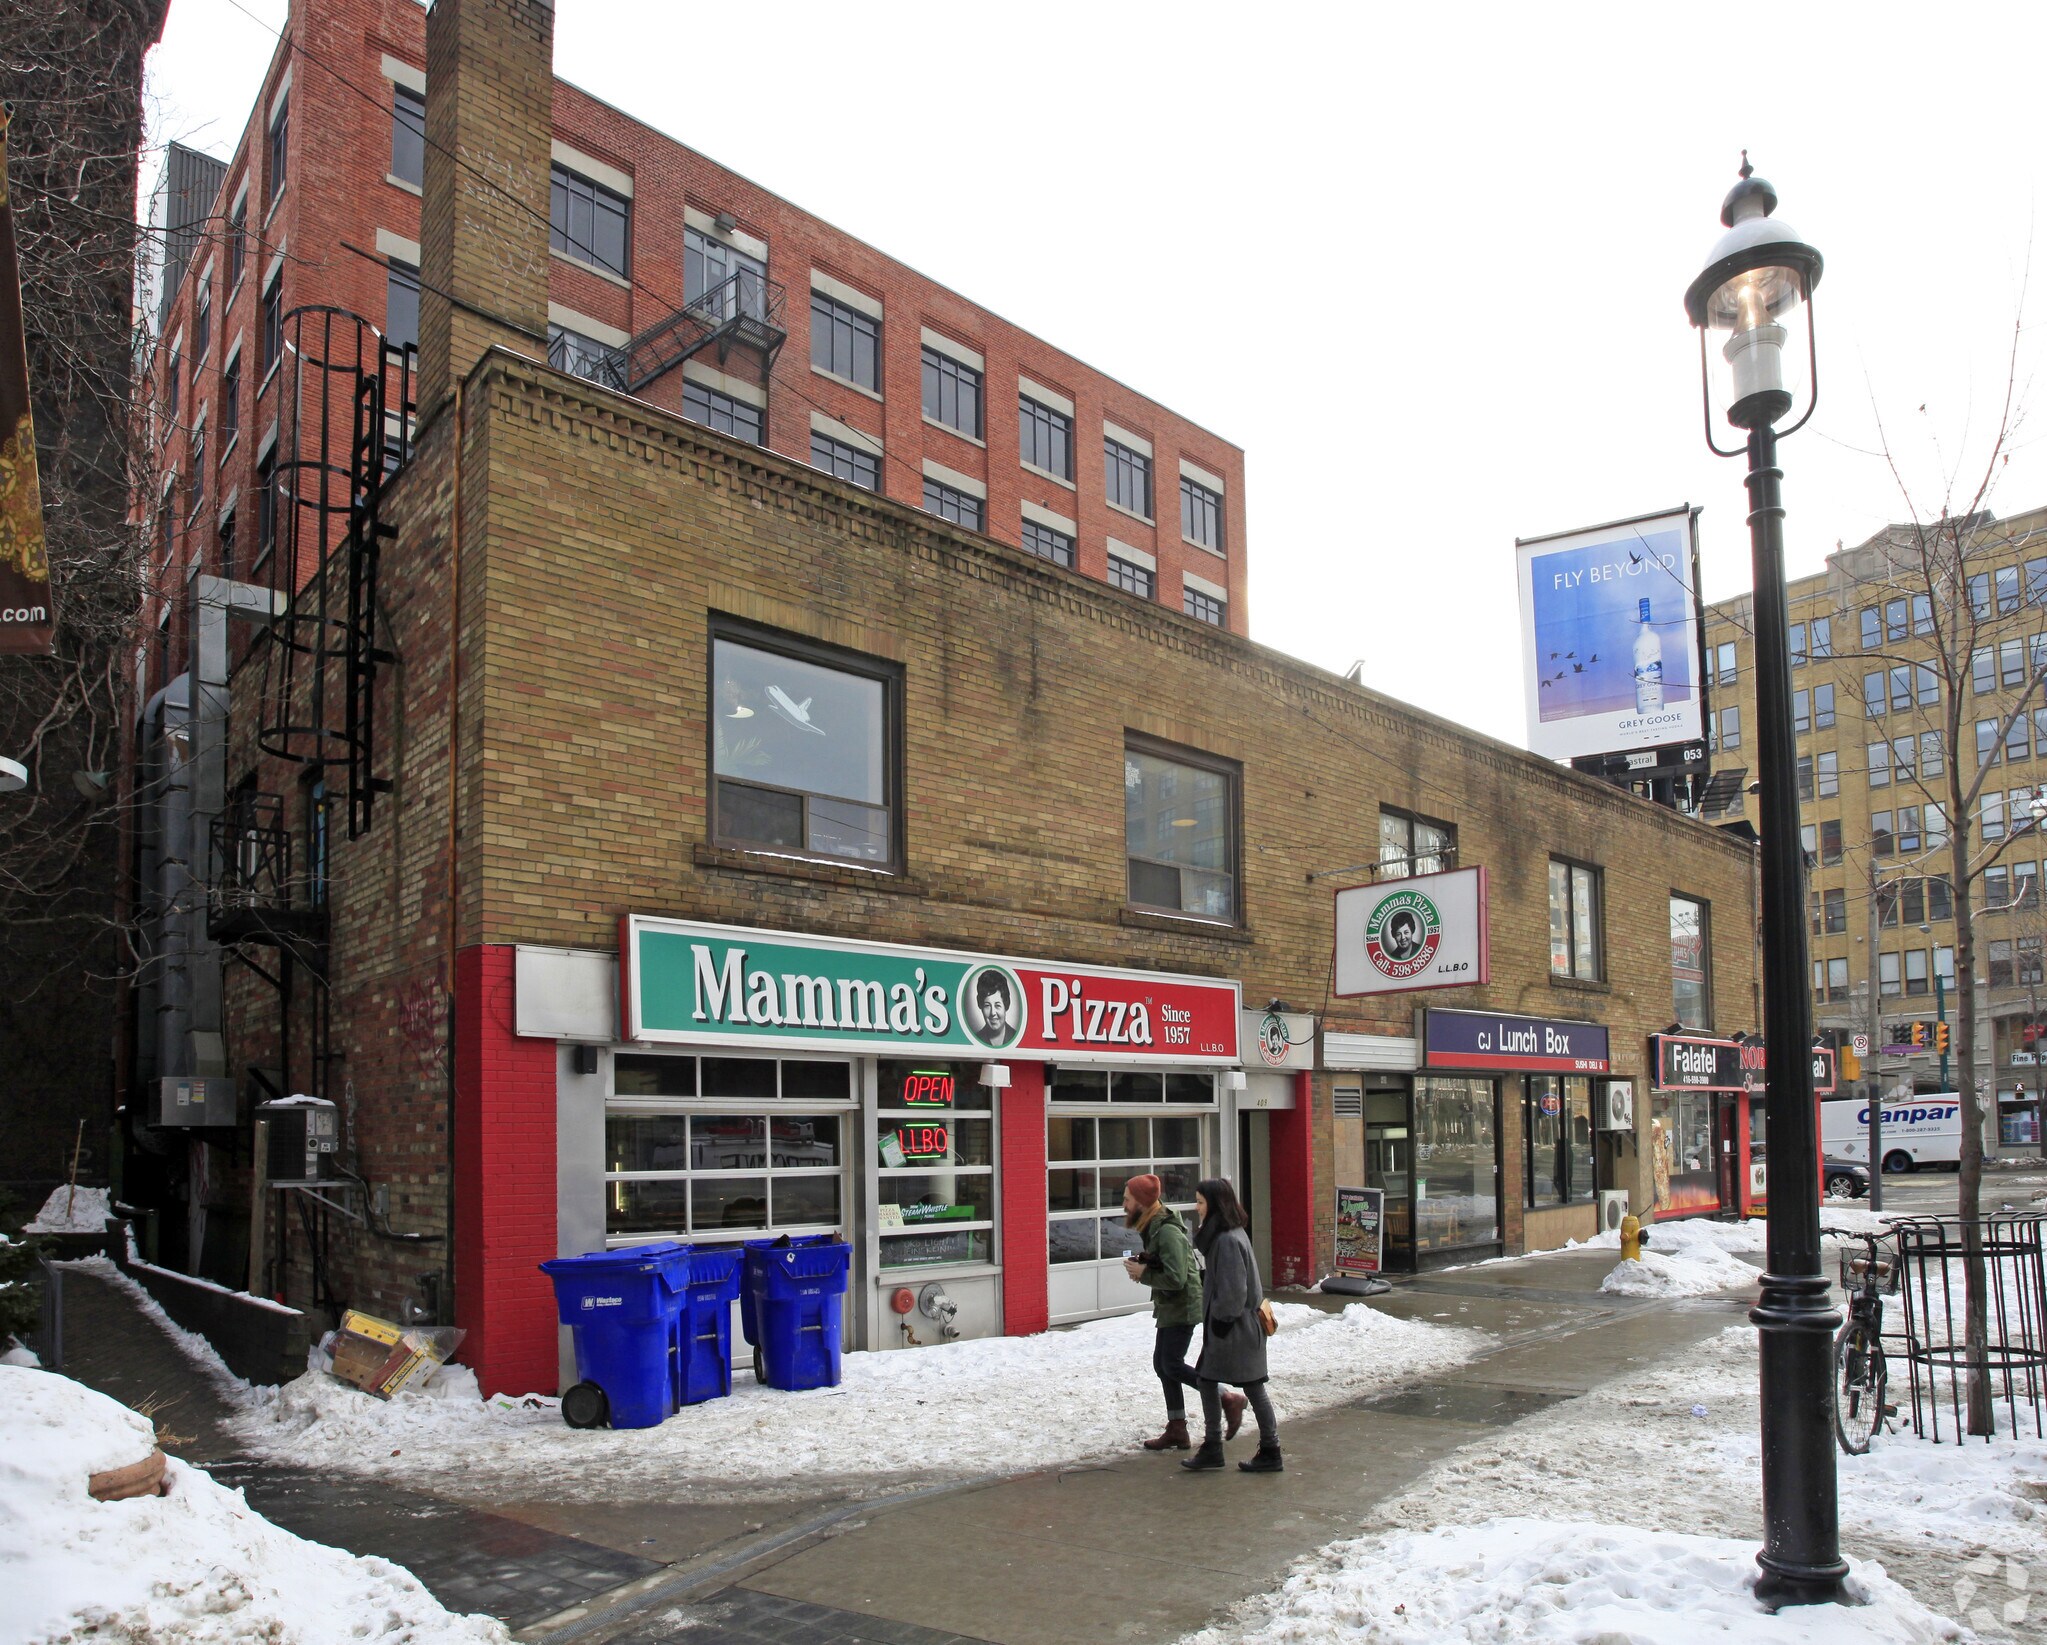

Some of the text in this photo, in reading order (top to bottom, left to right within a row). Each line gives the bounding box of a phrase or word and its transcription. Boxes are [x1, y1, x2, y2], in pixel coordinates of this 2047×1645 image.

[1554, 553, 1675, 590] FLY BEYOND
[1618, 712, 1682, 729] GREY GOOSE
[1683, 748, 1702, 761] 053
[1368, 894, 1435, 930] Mamma's Pizza
[1365, 925, 1440, 943] Since 1957
[1372, 950, 1391, 973] Call:
[690, 943, 950, 1036] Mamma's
[1040, 976, 1154, 1047] Pizza
[1161, 1004, 1191, 1023] Since
[1163, 1026, 1191, 1045] 1957
[1477, 1023, 1570, 1055] CJ Lunch Box
[1673, 1044, 1717, 1074] Falafel
[2012, 1053, 2029, 1062] Fine
[904, 1075, 955, 1102] OPEN
[1857, 1106, 1959, 1125] Canpar
[898, 1127, 948, 1154] LLBO
